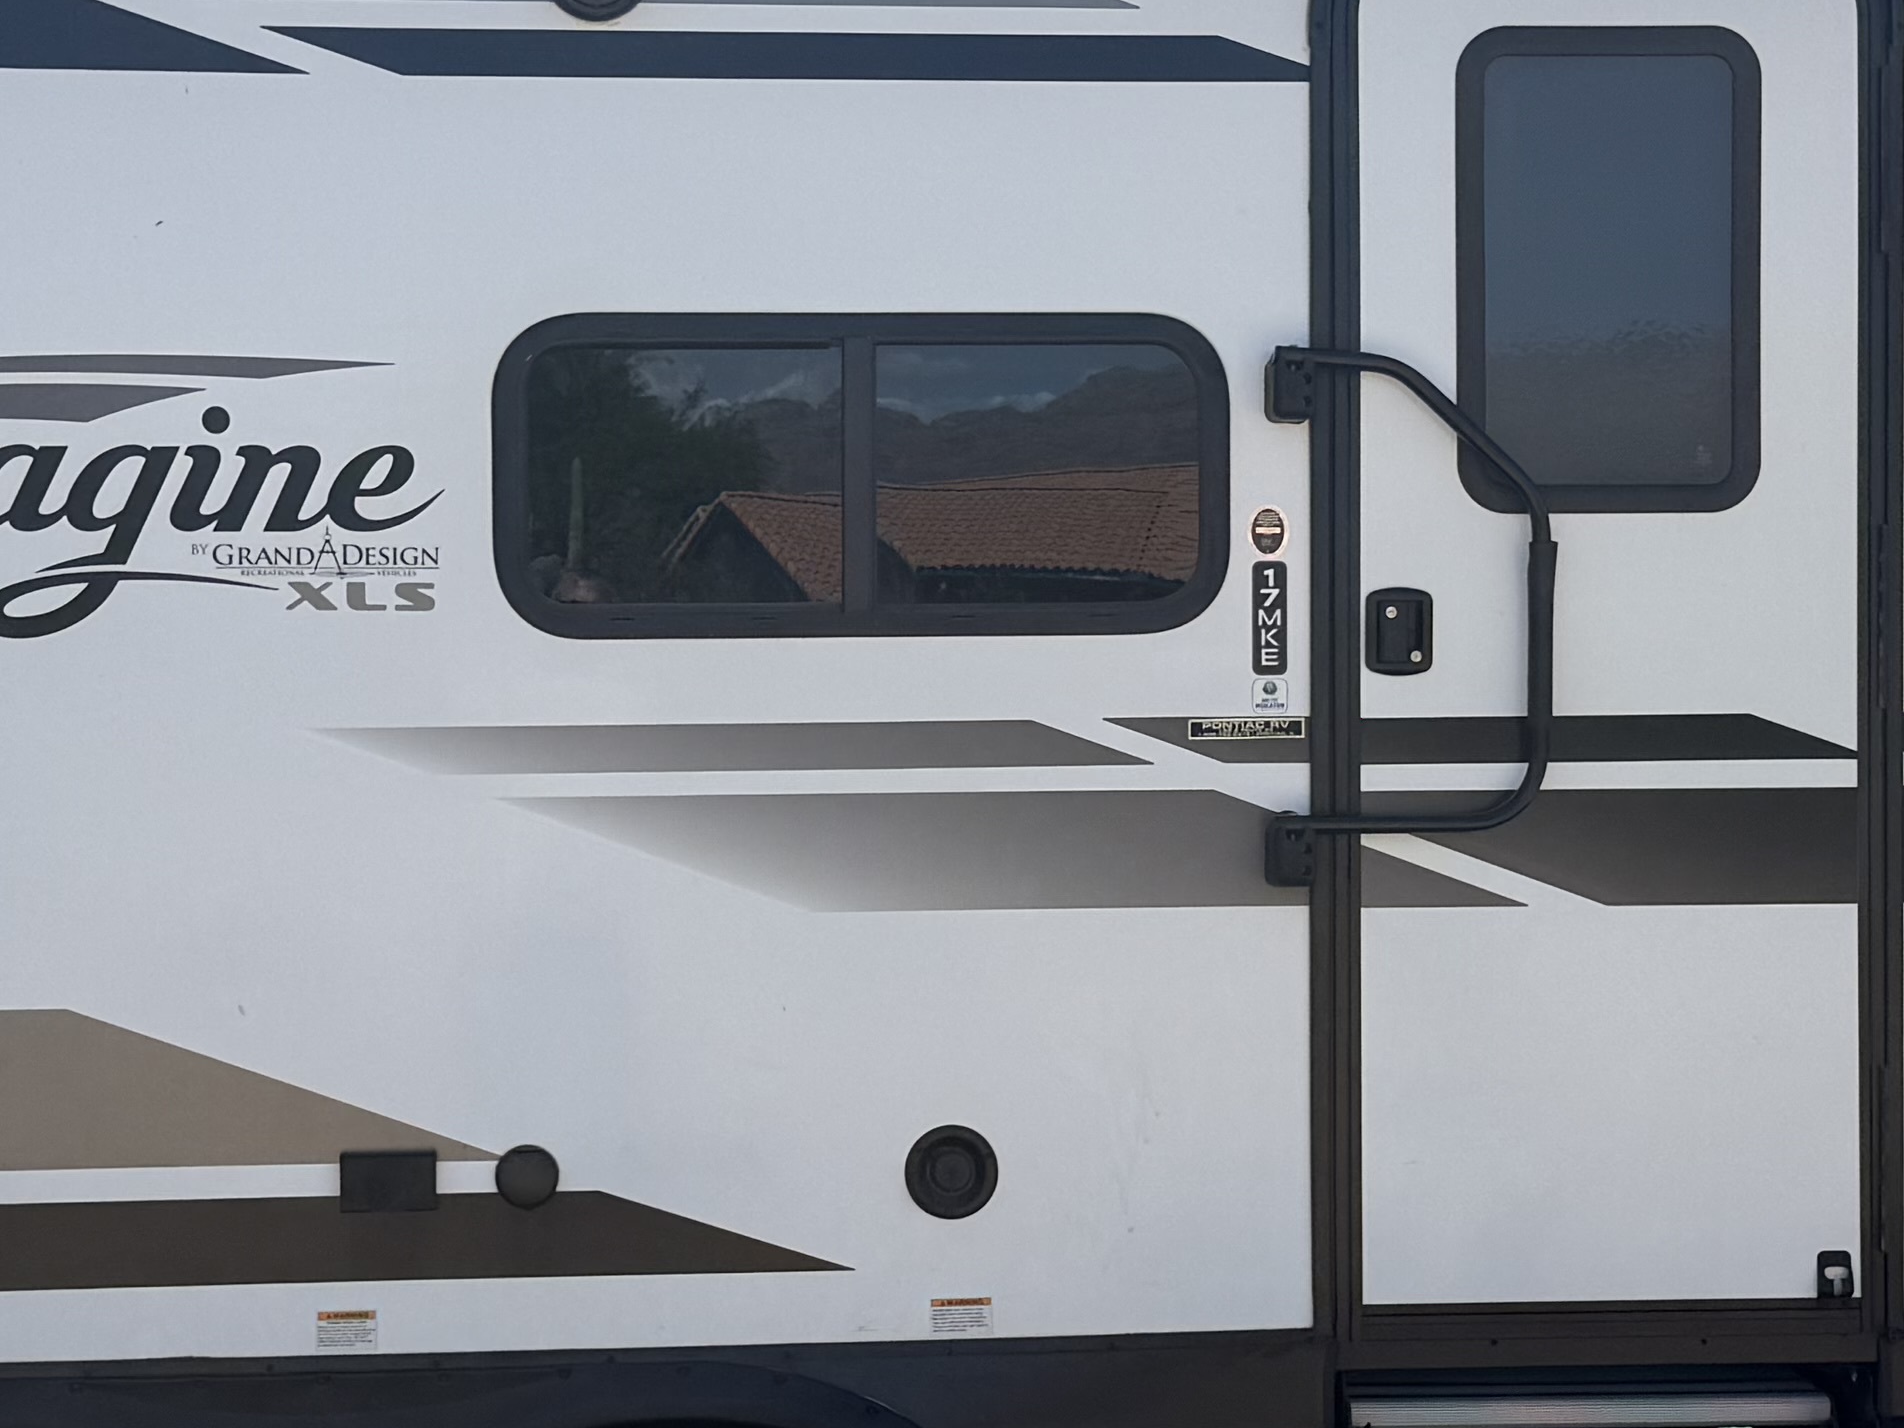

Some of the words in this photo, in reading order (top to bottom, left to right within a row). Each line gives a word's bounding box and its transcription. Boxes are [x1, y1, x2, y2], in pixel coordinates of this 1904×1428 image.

[190, 543, 209, 556] BY
[211, 543, 315, 567] GRAND
[341, 543, 440, 567] DESIGN
[284, 581, 436, 613] XLS
[1258, 567, 1282, 667] 17MKE
